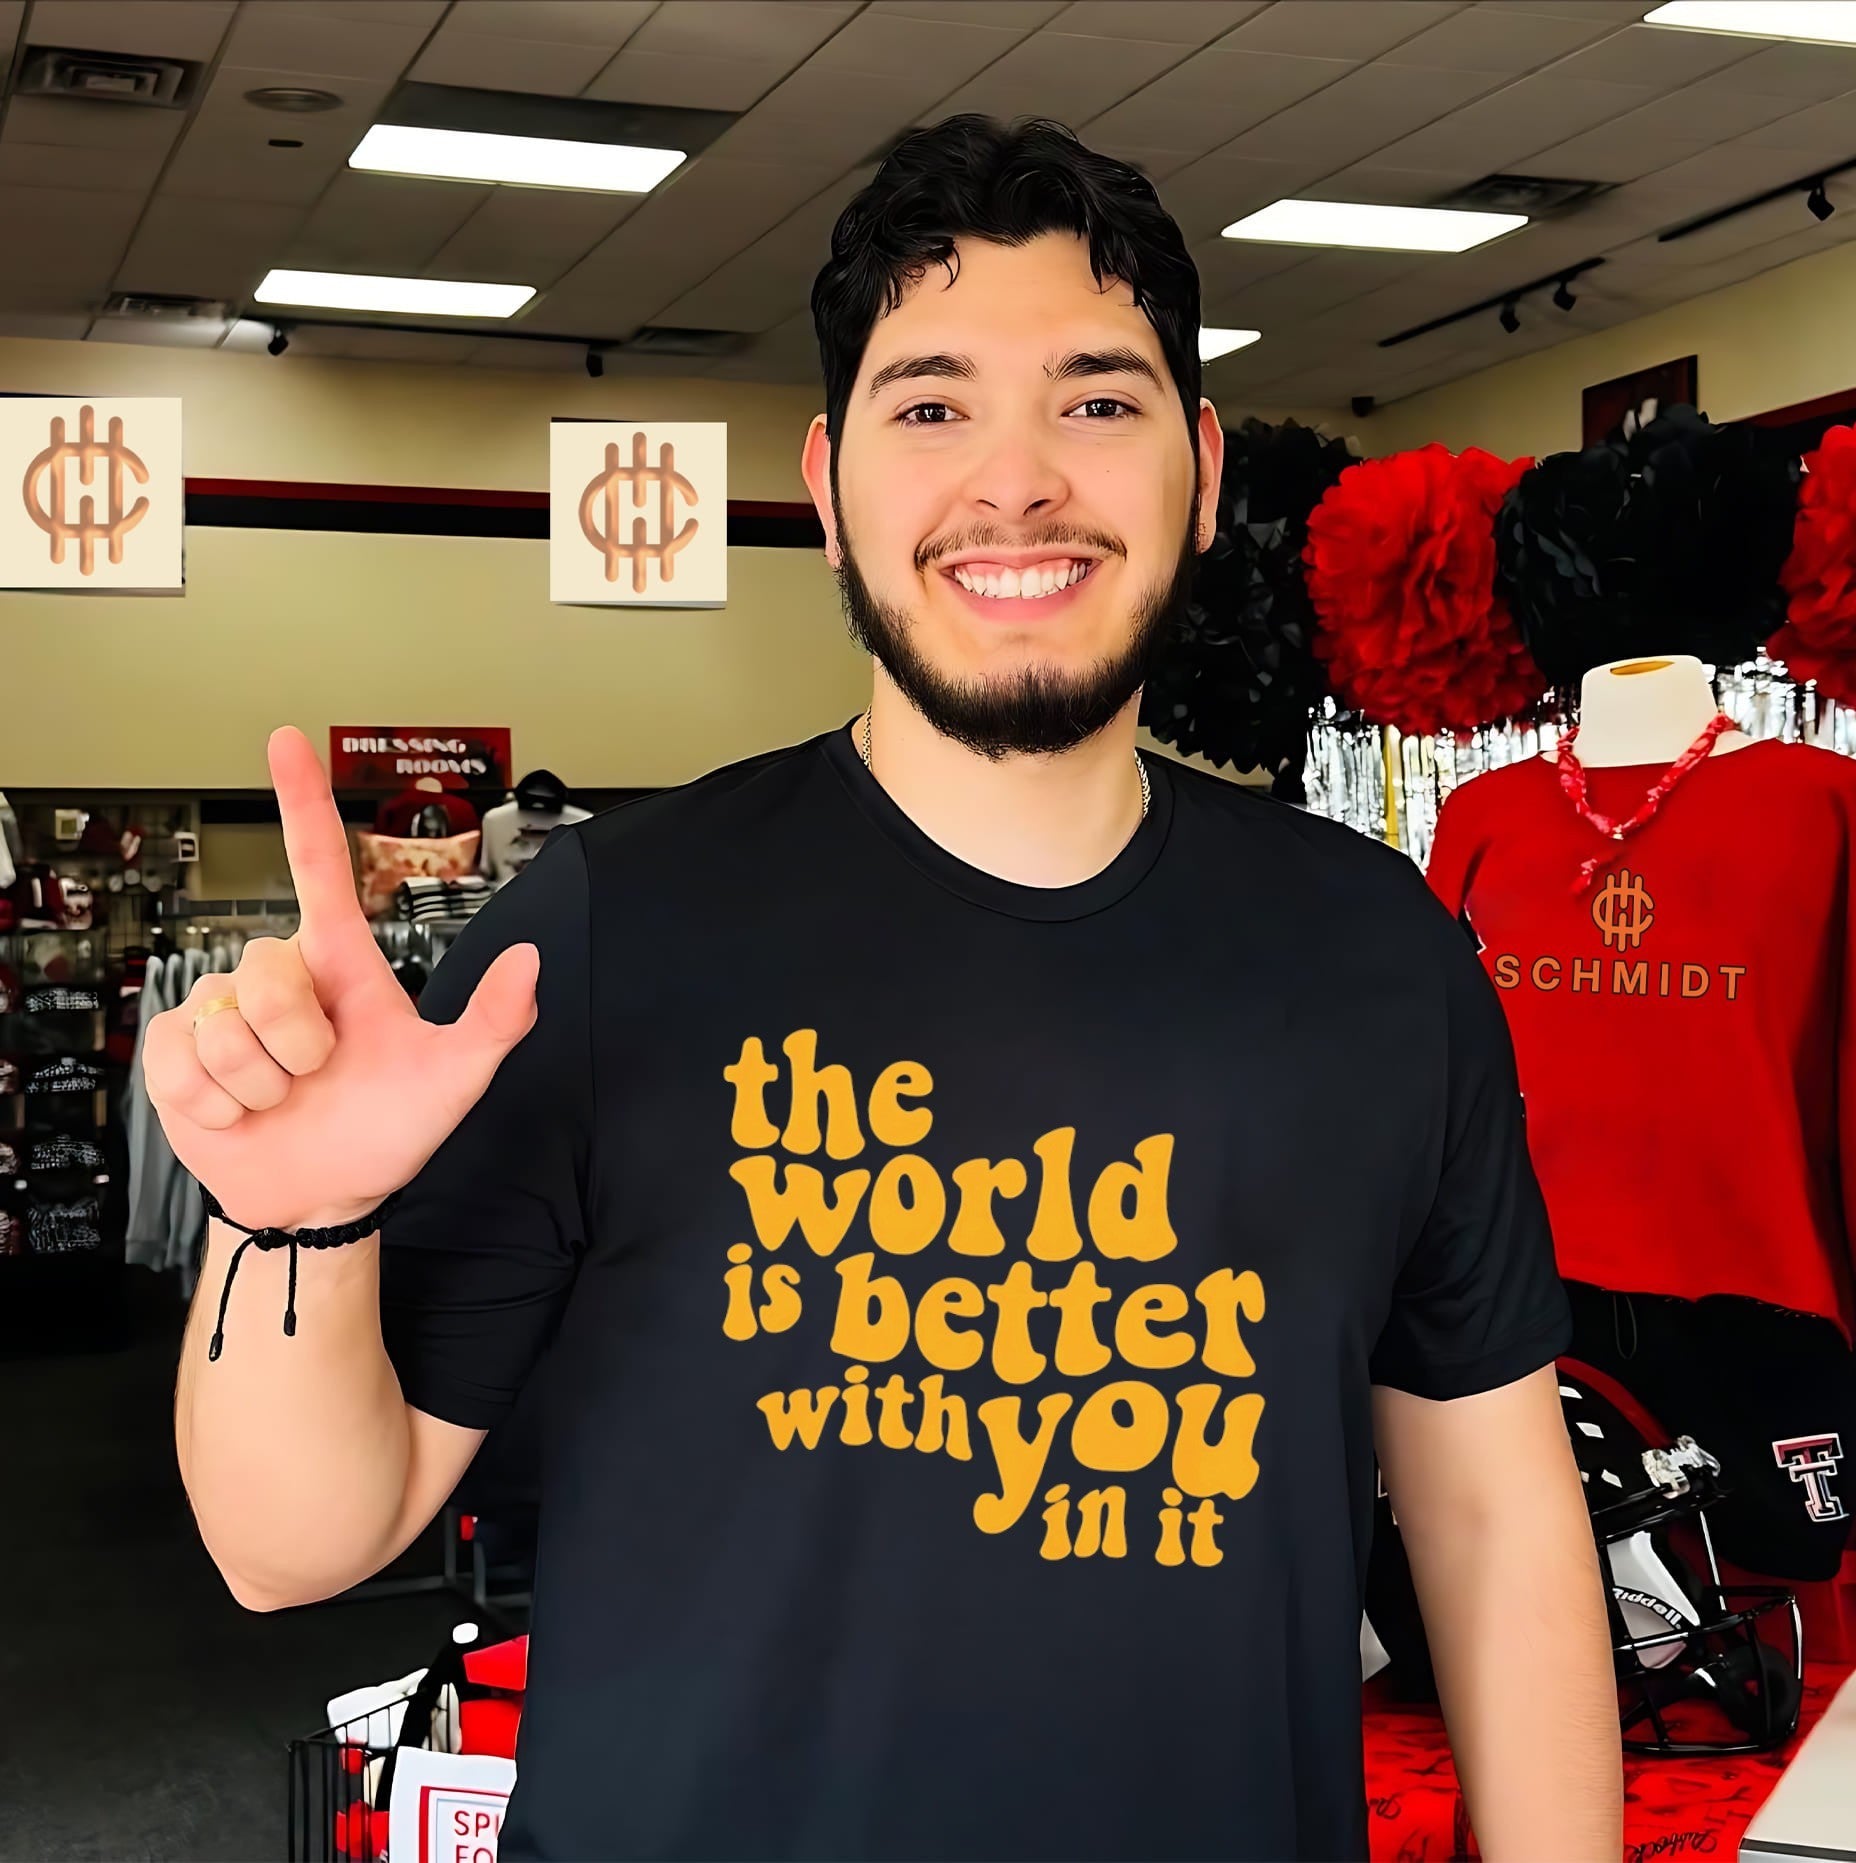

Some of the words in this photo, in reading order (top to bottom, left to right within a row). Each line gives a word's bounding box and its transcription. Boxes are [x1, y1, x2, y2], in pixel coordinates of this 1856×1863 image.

[396, 758, 487, 775] ROOMS
[1494, 954, 1747, 1000] SCHMIDT
[723, 1028, 934, 1161] the
[728, 1126, 1178, 1262] world
[722, 1242, 803, 1341] is
[829, 1251, 1266, 1385] better
[756, 1364, 973, 1461] with
[973, 1380, 1266, 1534] you
[1039, 1483, 1128, 1561] in
[1154, 1487, 1224, 1567] it
